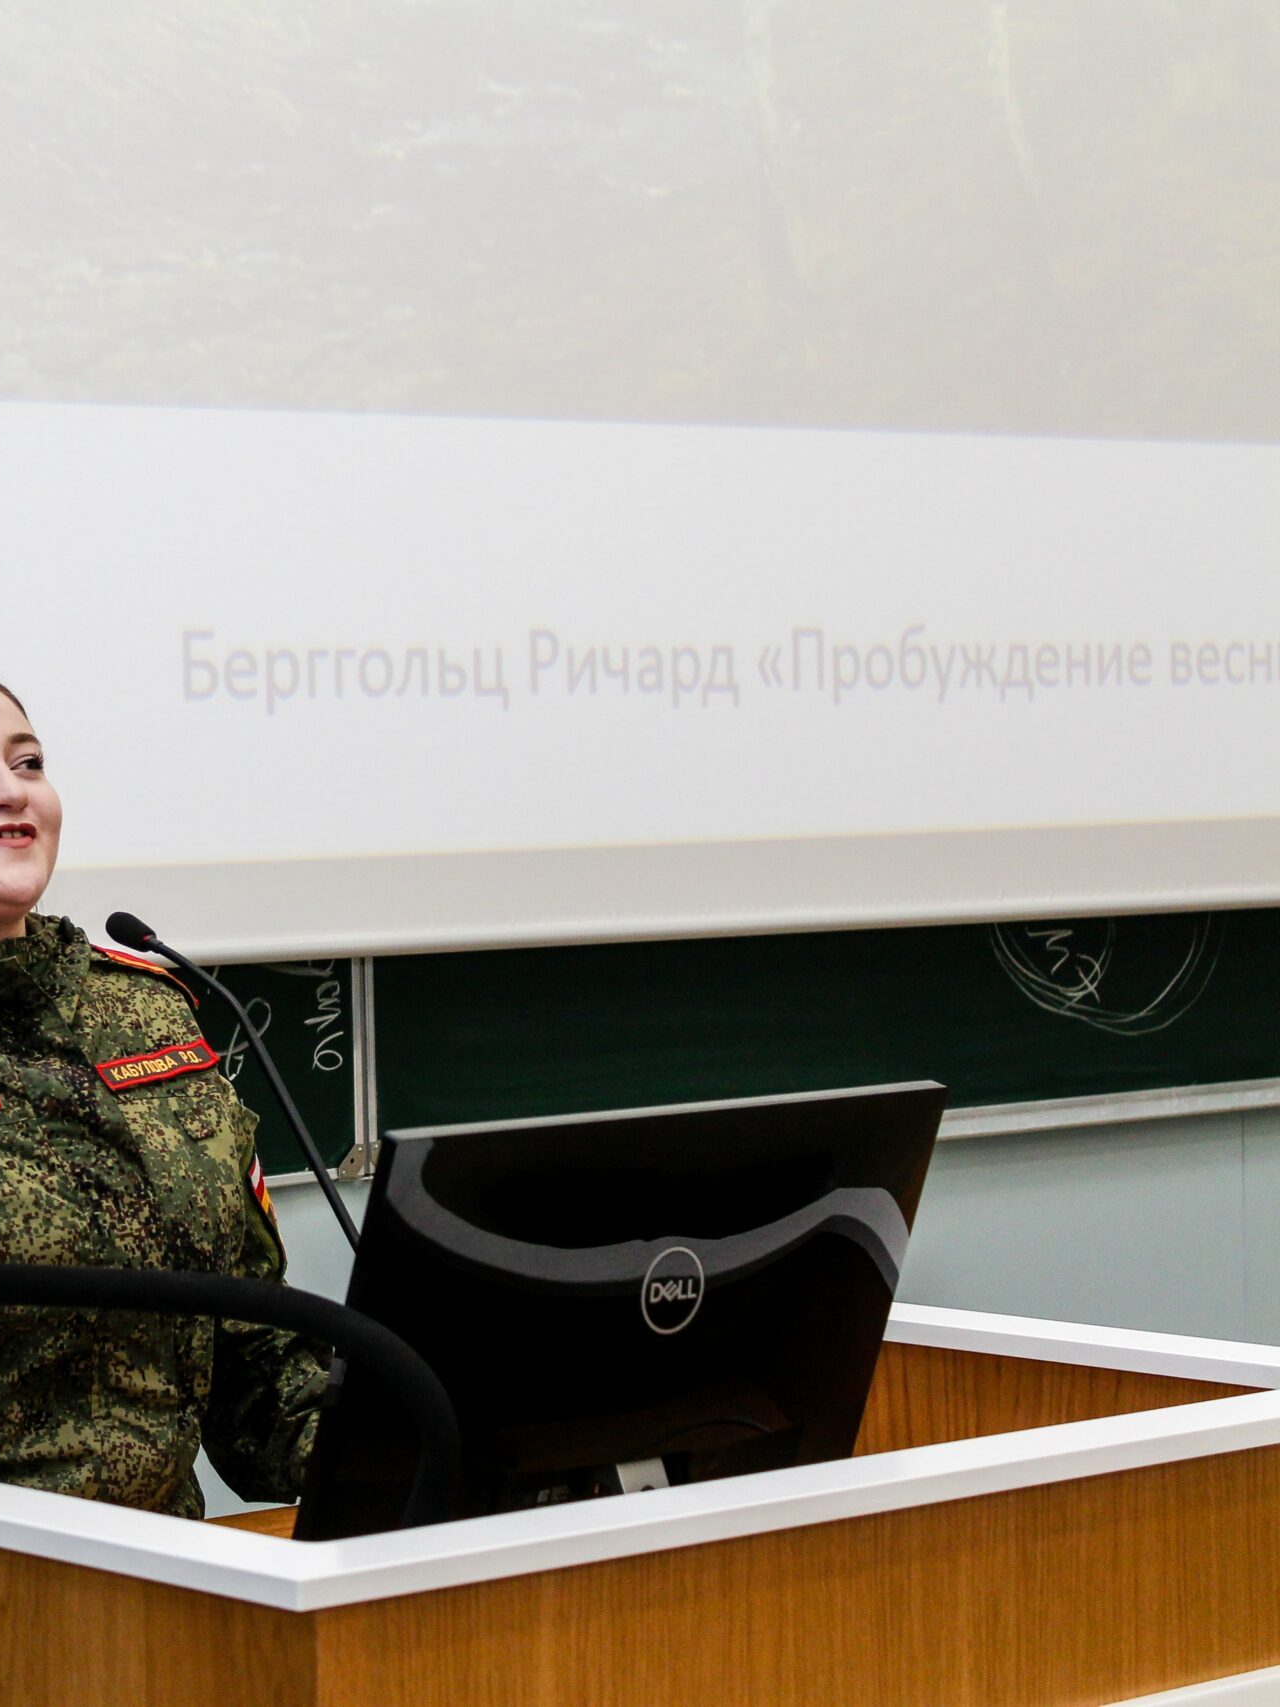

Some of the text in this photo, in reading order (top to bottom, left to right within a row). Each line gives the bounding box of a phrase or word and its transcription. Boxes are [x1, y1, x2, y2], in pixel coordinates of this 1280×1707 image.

[181, 624, 1280, 715] Берггольц Ричард «Пробуждение весн
[110, 1055, 178, 1081] КАБУЛОВА
[650, 1279, 697, 1304] DELL
